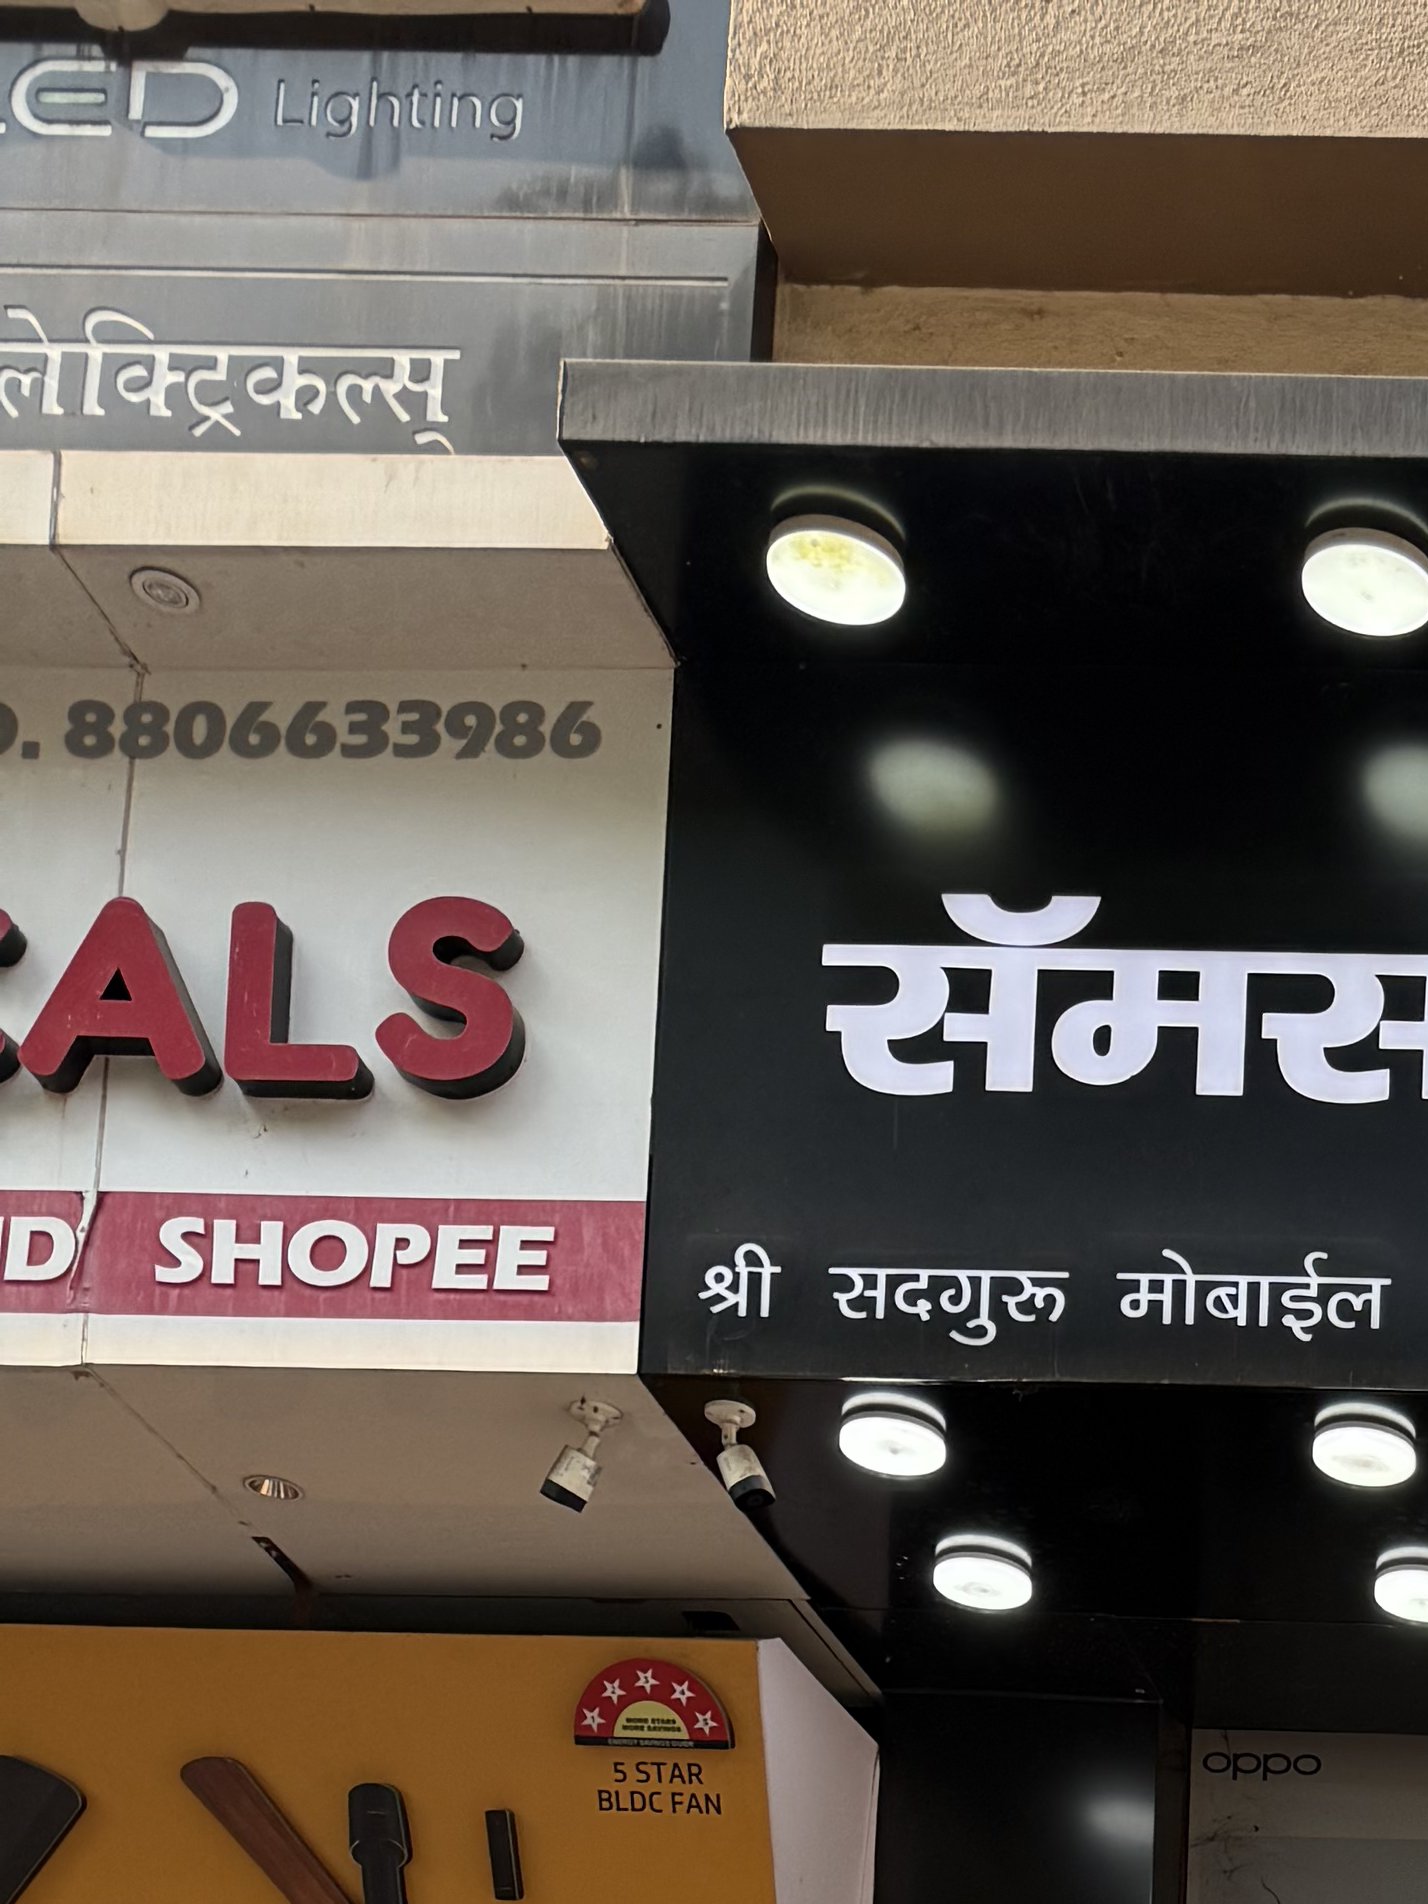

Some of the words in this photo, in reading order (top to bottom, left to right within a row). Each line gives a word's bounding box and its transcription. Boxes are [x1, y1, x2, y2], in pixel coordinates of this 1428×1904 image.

[0, 59, 238, 138] ED
[275, 79, 523, 141] Lighting
[63, 700, 601, 760] 8806633986
[0, 895, 525, 1100] ALS
[154, 1215, 556, 1292] SHOPEE
[698, 1243, 781, 1320] श्री
[829, 1265, 1069, 1346] सदगुरू
[1116, 1249, 1391, 1341] मोबाईल
[613, 1762, 627, 1783] 5
[635, 1762, 703, 1784] STAR
[1203, 1751, 1322, 1781] oppo
[598, 1790, 663, 1813] BLDC
[671, 1792, 721, 1815] FAN
